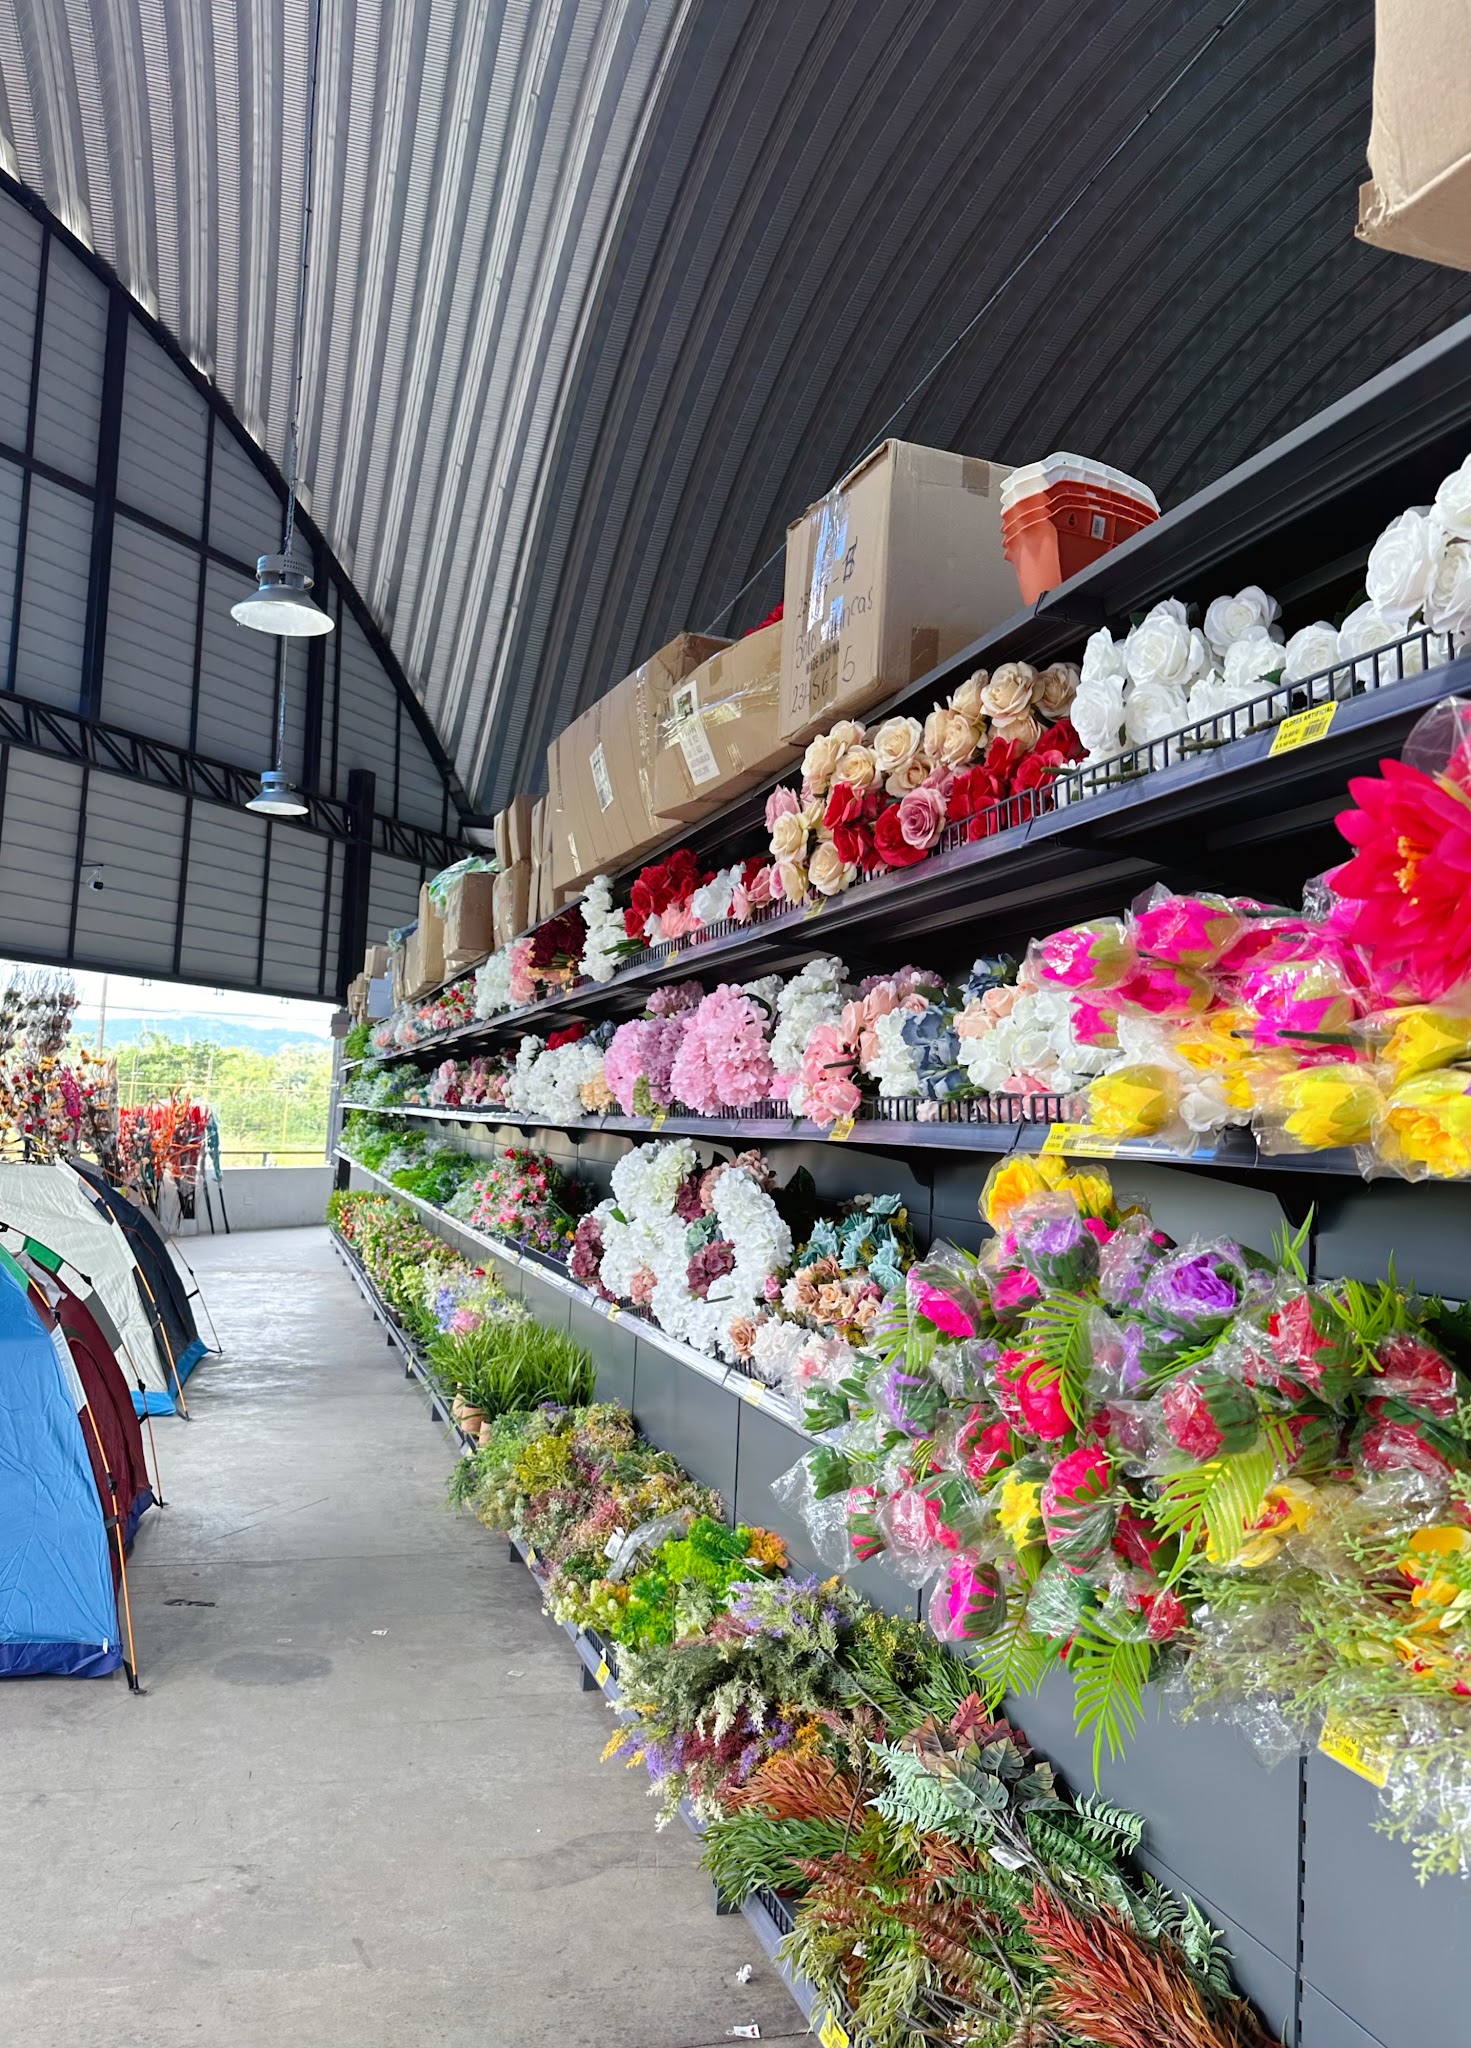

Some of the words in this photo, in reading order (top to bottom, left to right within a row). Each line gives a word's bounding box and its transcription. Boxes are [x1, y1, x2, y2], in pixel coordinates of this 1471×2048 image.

[796, 634, 817, 669] Solo
[1283, 716, 1303, 730] FLORES
[1304, 705, 1334, 721] ARTIFICIAL
